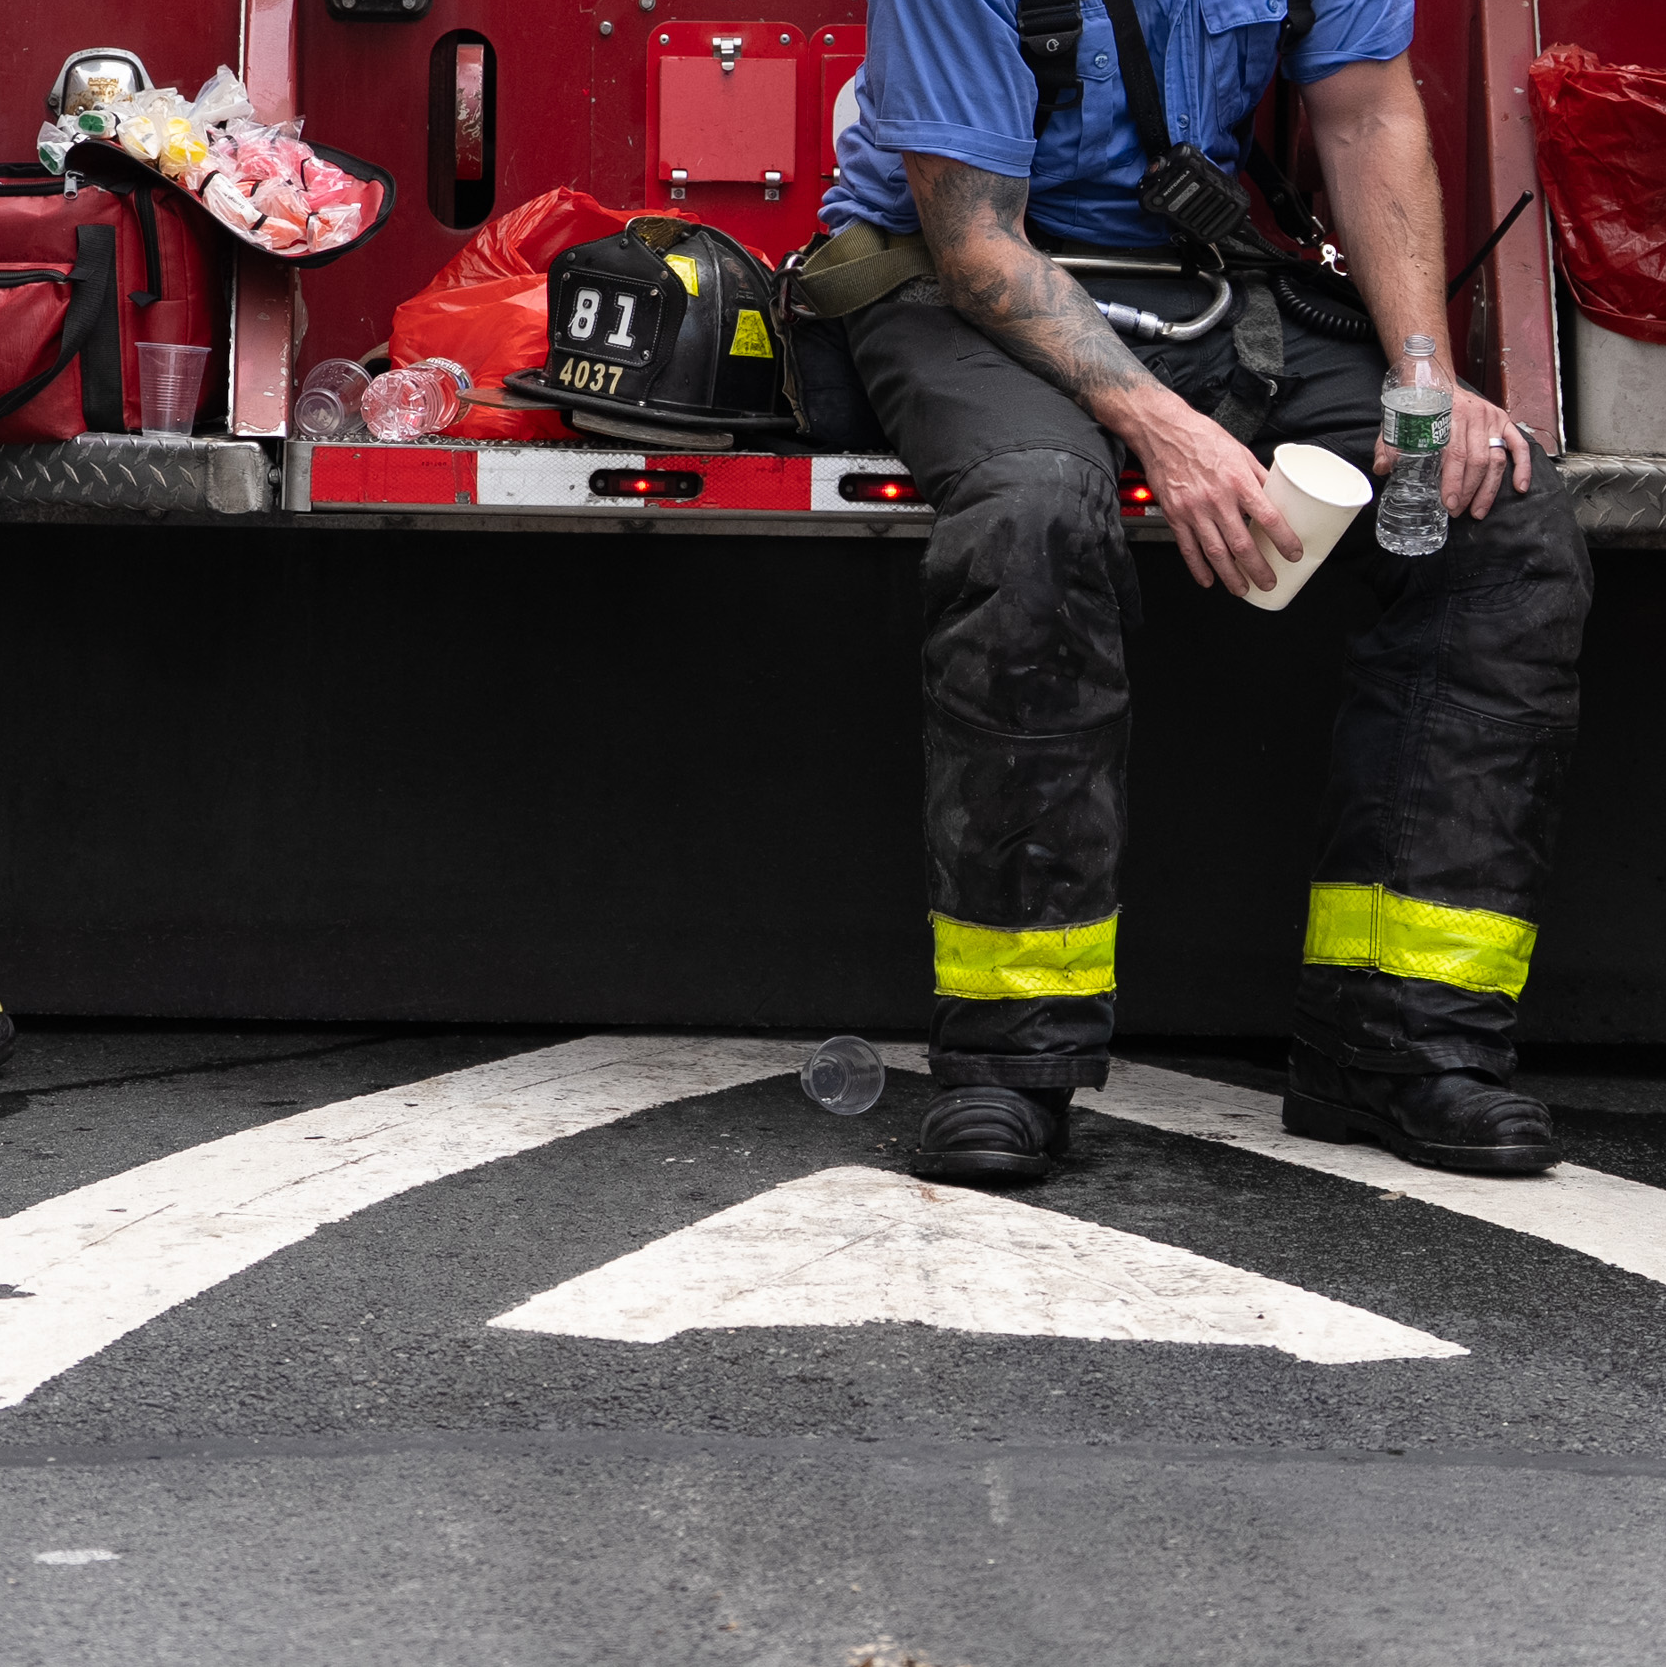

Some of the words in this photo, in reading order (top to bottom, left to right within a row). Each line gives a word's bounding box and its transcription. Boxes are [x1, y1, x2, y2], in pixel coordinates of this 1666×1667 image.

[1163, 170, 1190, 197] MOTOROLA
[569, 288, 635, 348] 81
[558, 357, 624, 395] 4037
